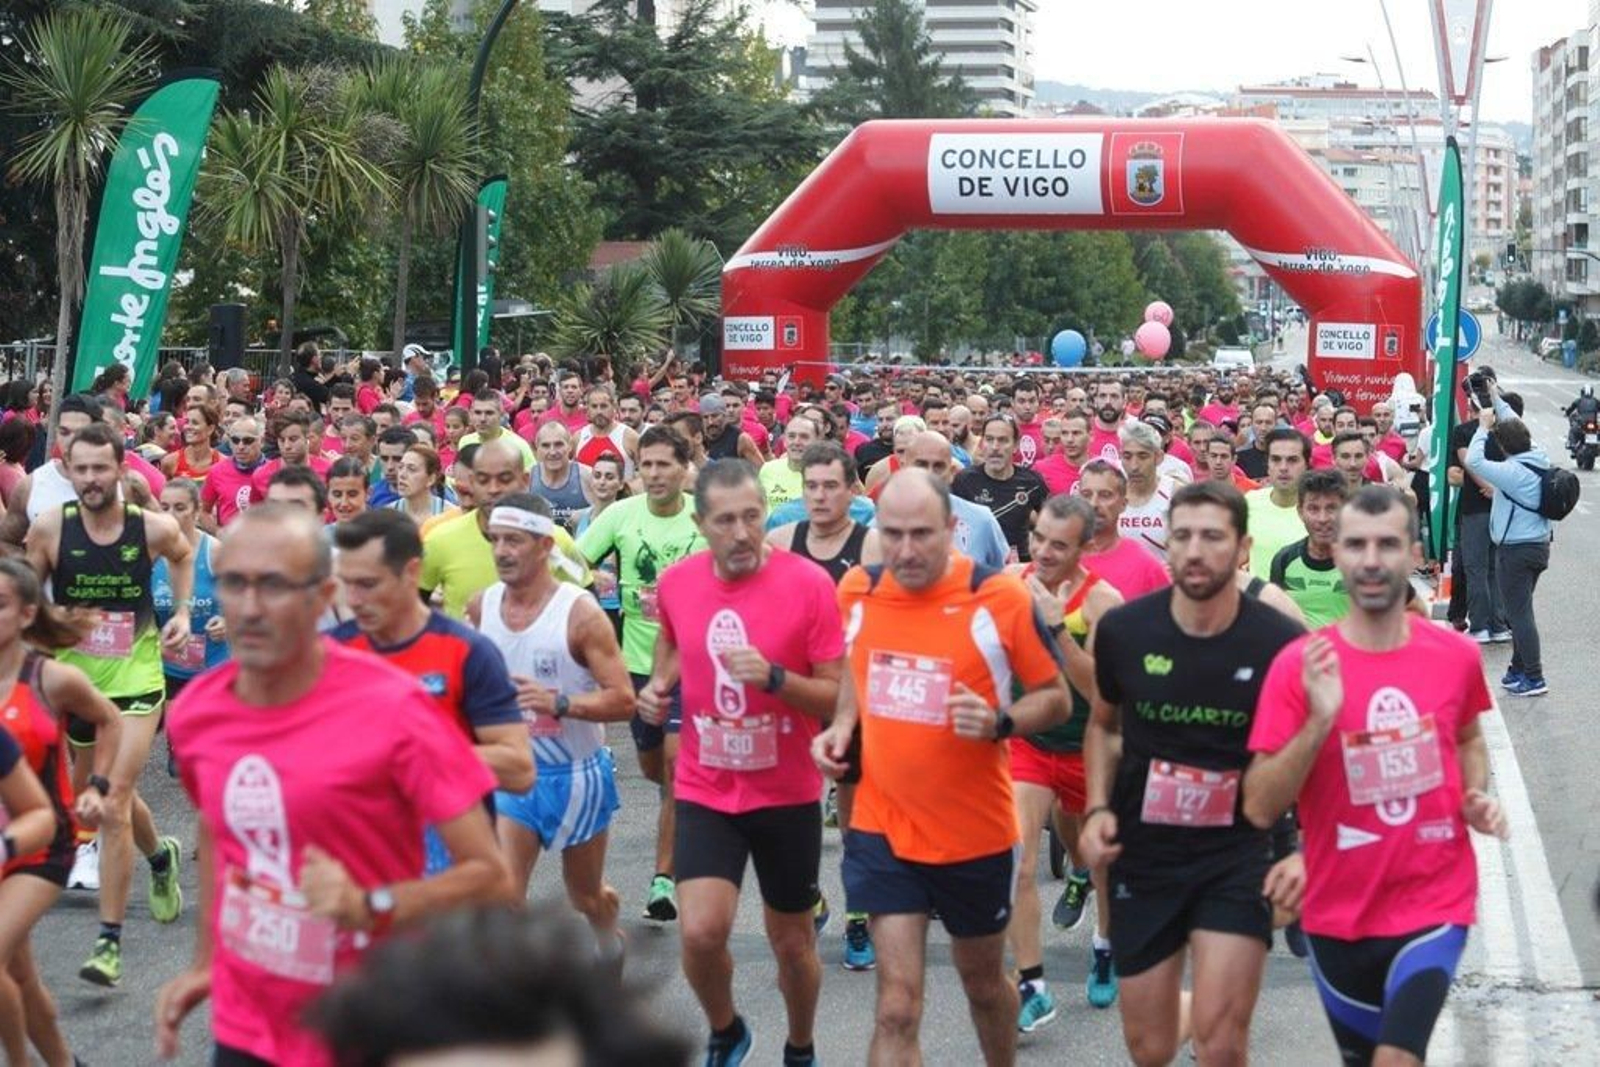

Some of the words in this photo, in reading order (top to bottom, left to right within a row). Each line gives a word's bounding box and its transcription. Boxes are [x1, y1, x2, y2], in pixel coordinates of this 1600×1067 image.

[941, 148, 1087, 170] CONCELLO
[958, 176, 993, 197] DE
[1003, 176, 1070, 197] VIGO
[740, 333, 763, 343] VIGO
[1319, 329, 1371, 340] CONCELLO
[1322, 341, 1335, 350] DE
[1337, 341, 1363, 351] VIGO
[1355, 387, 1392, 401] fermos
[1120, 517, 1163, 529] REGA
[886, 674, 927, 704] 445
[1159, 702, 1250, 728] CUARTO
[1377, 745, 1418, 780] 153
[1174, 786, 1211, 810] 127
